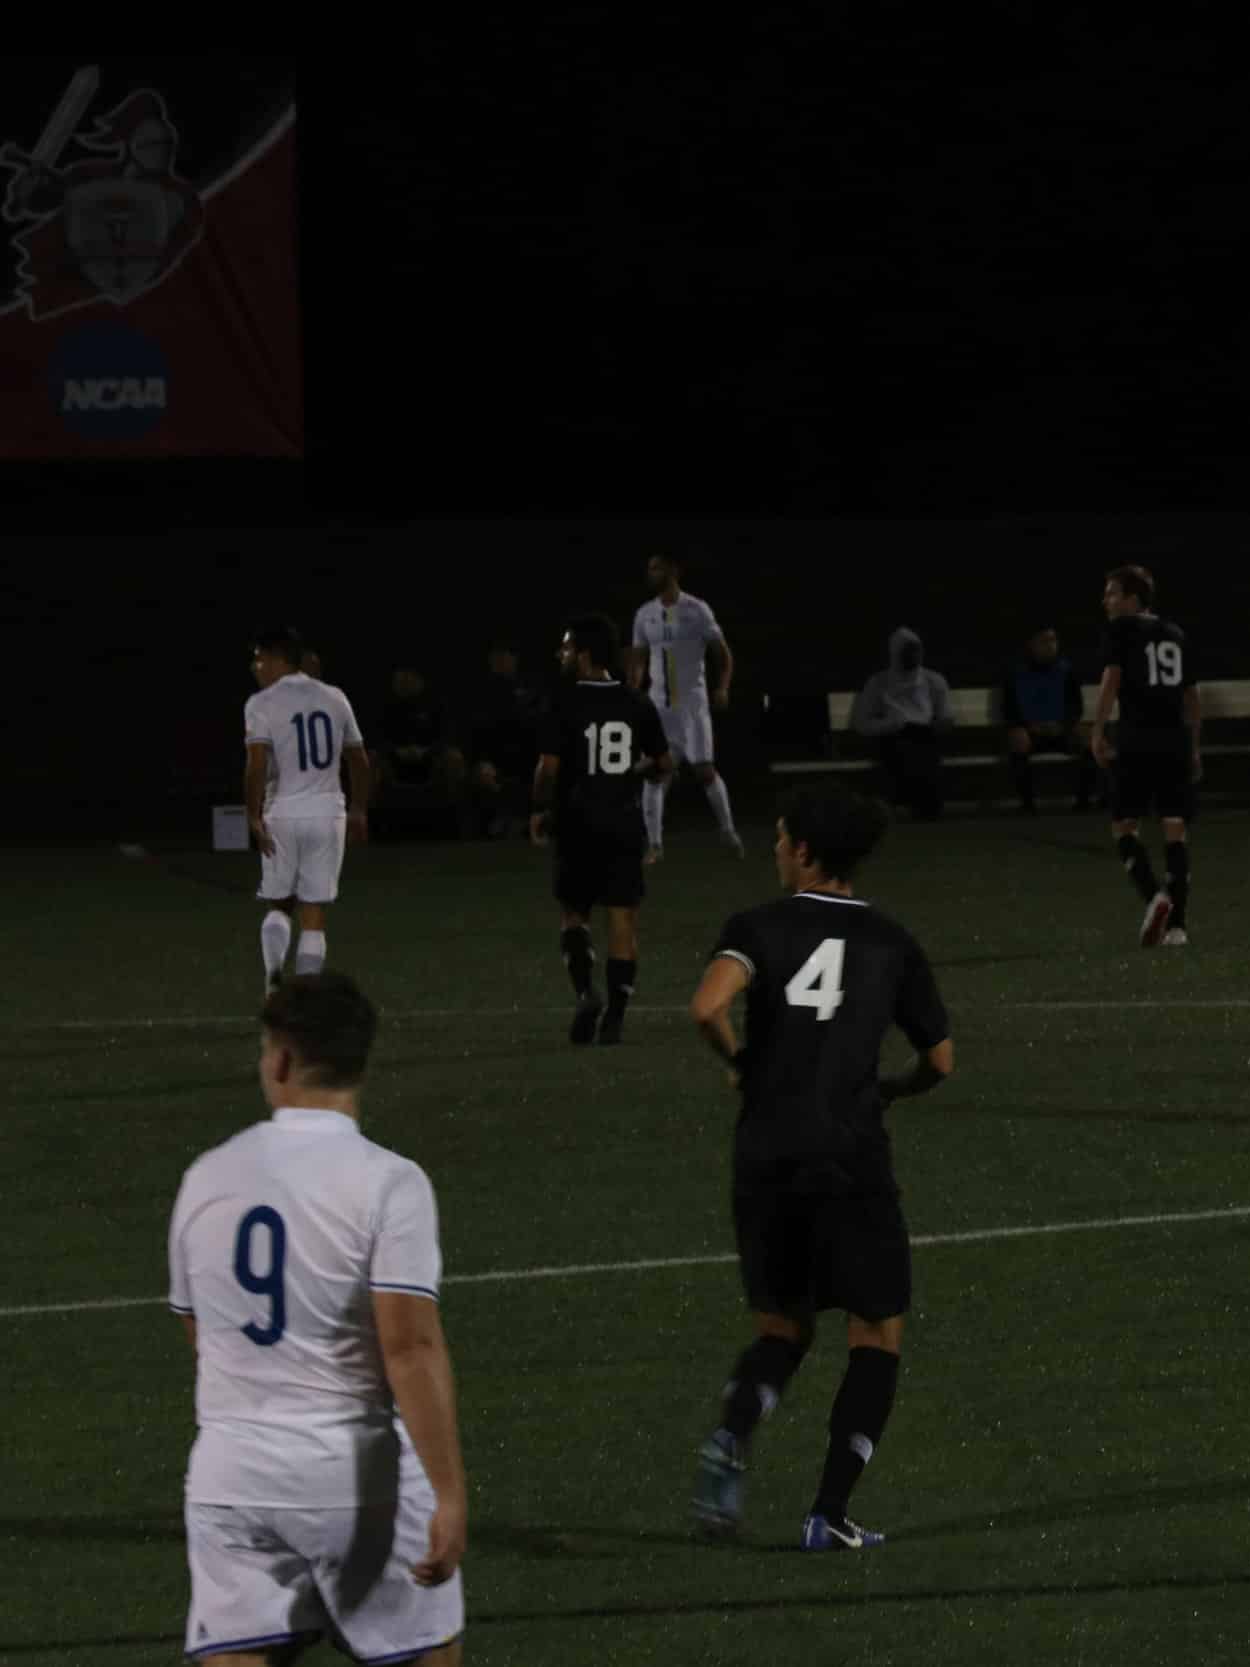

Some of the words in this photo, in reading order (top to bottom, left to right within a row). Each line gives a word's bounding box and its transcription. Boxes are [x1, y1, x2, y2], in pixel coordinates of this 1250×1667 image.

[62, 379, 167, 411] NCAA
[1145, 641, 1182, 686] 19
[290, 710, 335, 772] 10
[584, 721, 632, 774] 18
[785, 938, 845, 1022] 4
[234, 1205, 286, 1347] 9
